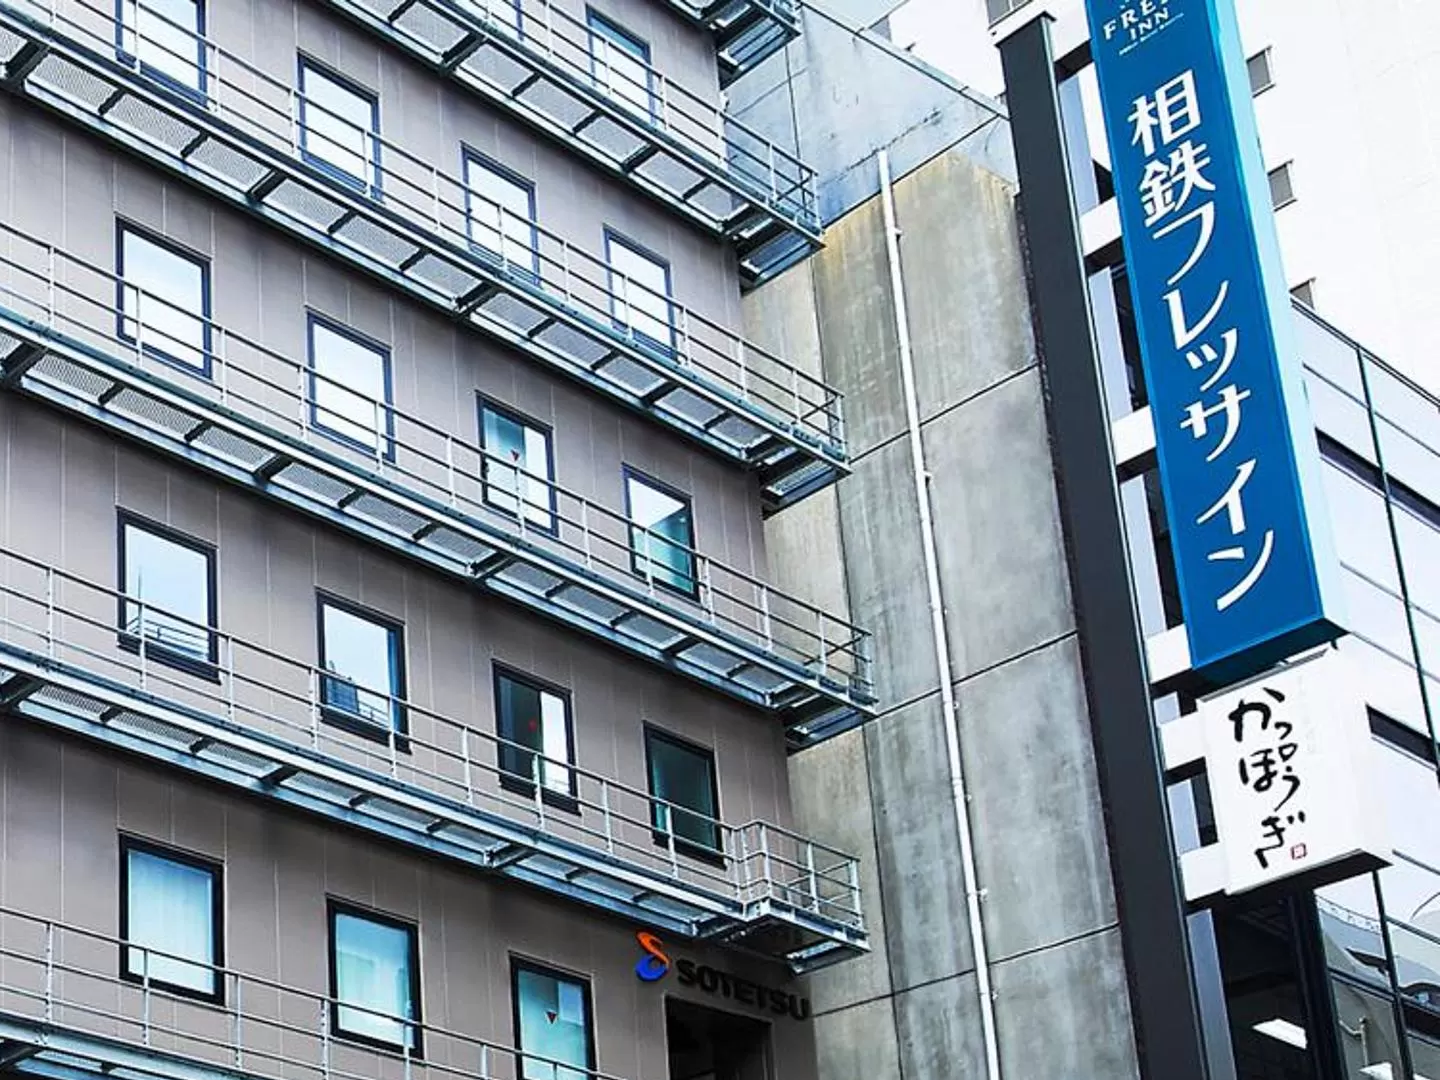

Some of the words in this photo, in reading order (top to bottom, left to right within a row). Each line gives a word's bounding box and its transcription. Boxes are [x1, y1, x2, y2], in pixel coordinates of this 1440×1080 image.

[1103, 0, 1169, 40] FRE
[1130, 7, 1169, 40] INN
[1127, 68, 1274, 612] 相鉄フレッサイン
[1228, 687, 1306, 869] かっぽうぎ
[676, 959, 810, 1021] SOTETSU
